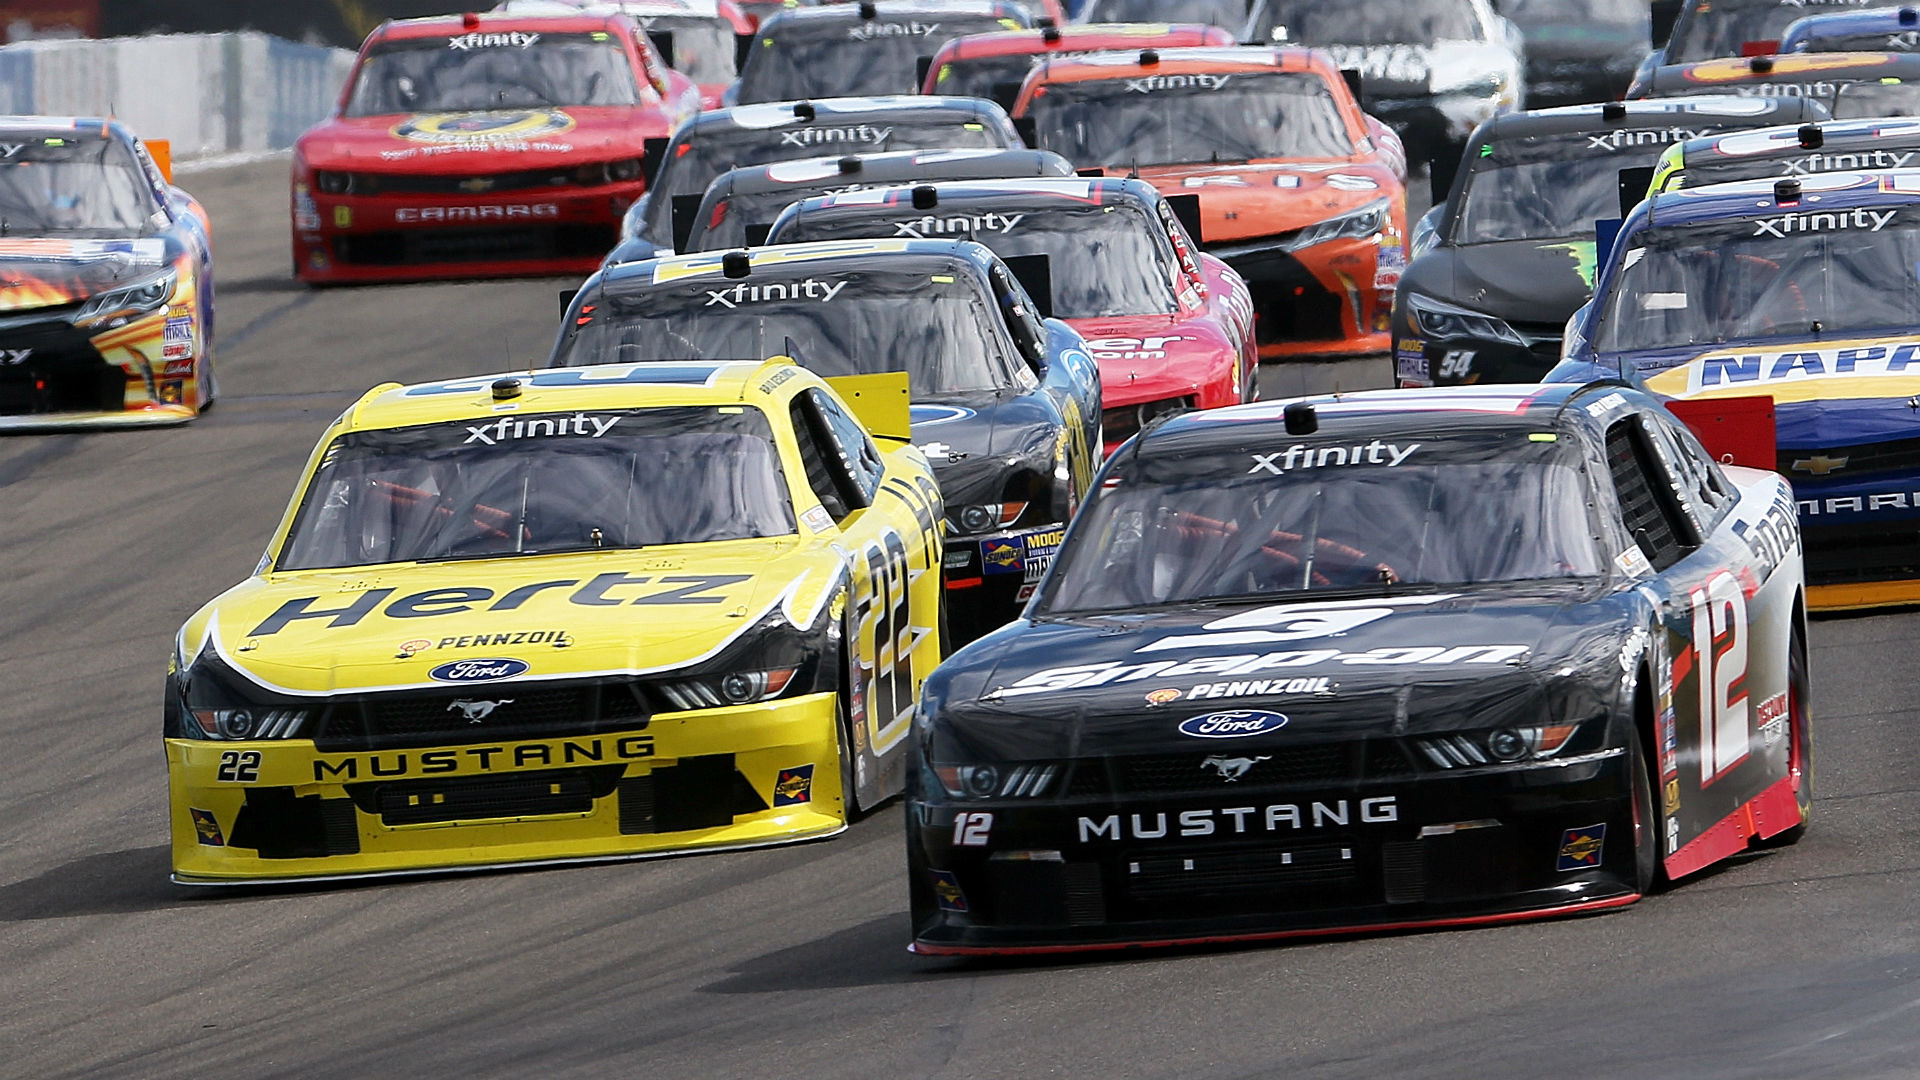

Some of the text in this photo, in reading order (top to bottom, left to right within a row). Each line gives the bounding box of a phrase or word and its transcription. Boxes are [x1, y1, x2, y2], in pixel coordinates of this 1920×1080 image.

[449, 32, 540, 49] xfinity
[850, 22, 940, 40] xfinity
[1124, 74, 1230, 93] xfinity
[781, 124, 893, 147] xfinity
[1586, 127, 1710, 150] xfinity
[1782, 150, 1916, 176] xfinity
[894, 212, 1024, 238] xfinity
[1753, 207, 1897, 238] xfinity
[705, 278, 848, 308] xfinity
[1438, 351, 1478, 377] 54
[1702, 345, 1920, 387] NAPA
[464, 413, 621, 445] xfinity
[1248, 440, 1421, 476] xfinity
[247, 571, 755, 638] Hertz
[435, 630, 568, 651] PENNZOIL
[448, 660, 514, 680] Ford
[1690, 567, 1750, 790] 12
[1186, 677, 1327, 701] PENNZOIL
[1199, 710, 1267, 734] Ford
[217, 750, 262, 783] 22
[313, 736, 656, 781] MUSTANG
[952, 812, 994, 846] 12
[1078, 796, 1398, 843] MUSTANG
